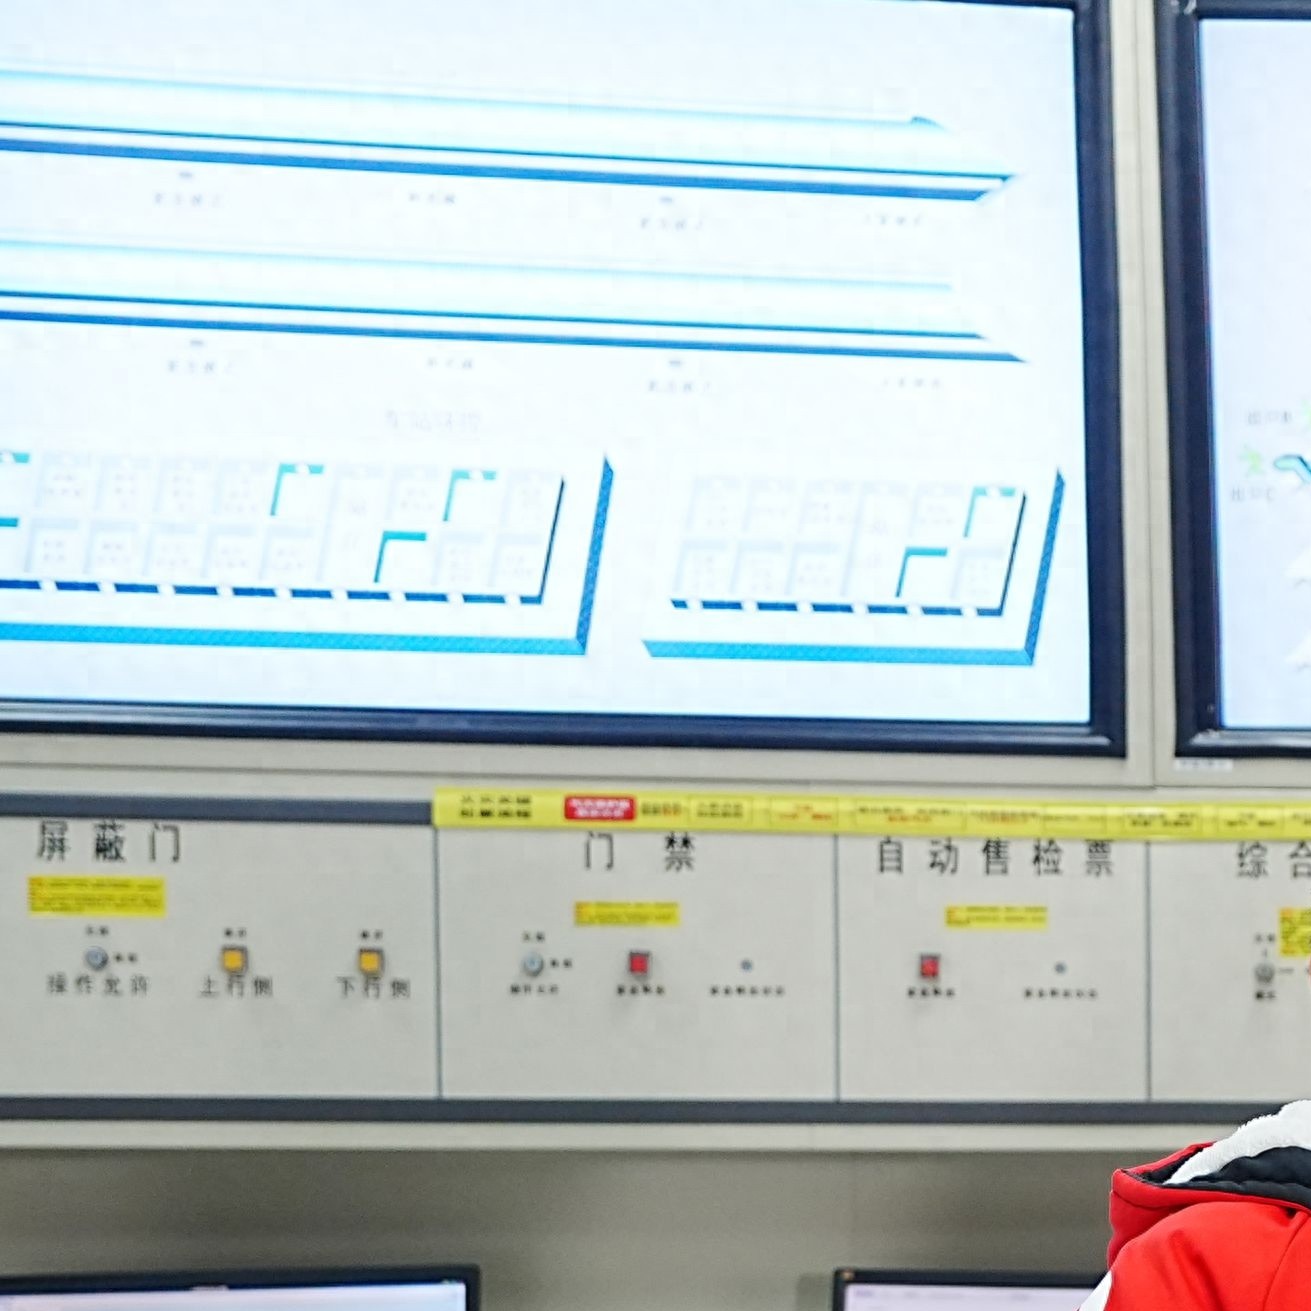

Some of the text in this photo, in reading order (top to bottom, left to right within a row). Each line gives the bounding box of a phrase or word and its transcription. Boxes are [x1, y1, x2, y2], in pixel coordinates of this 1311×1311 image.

[38, 820, 181, 862] 屏蔽门
[878, 836, 1115, 877] 自动售检票
[201, 975, 273, 998] 上行侧
[337, 975, 411, 998] 下行侧
